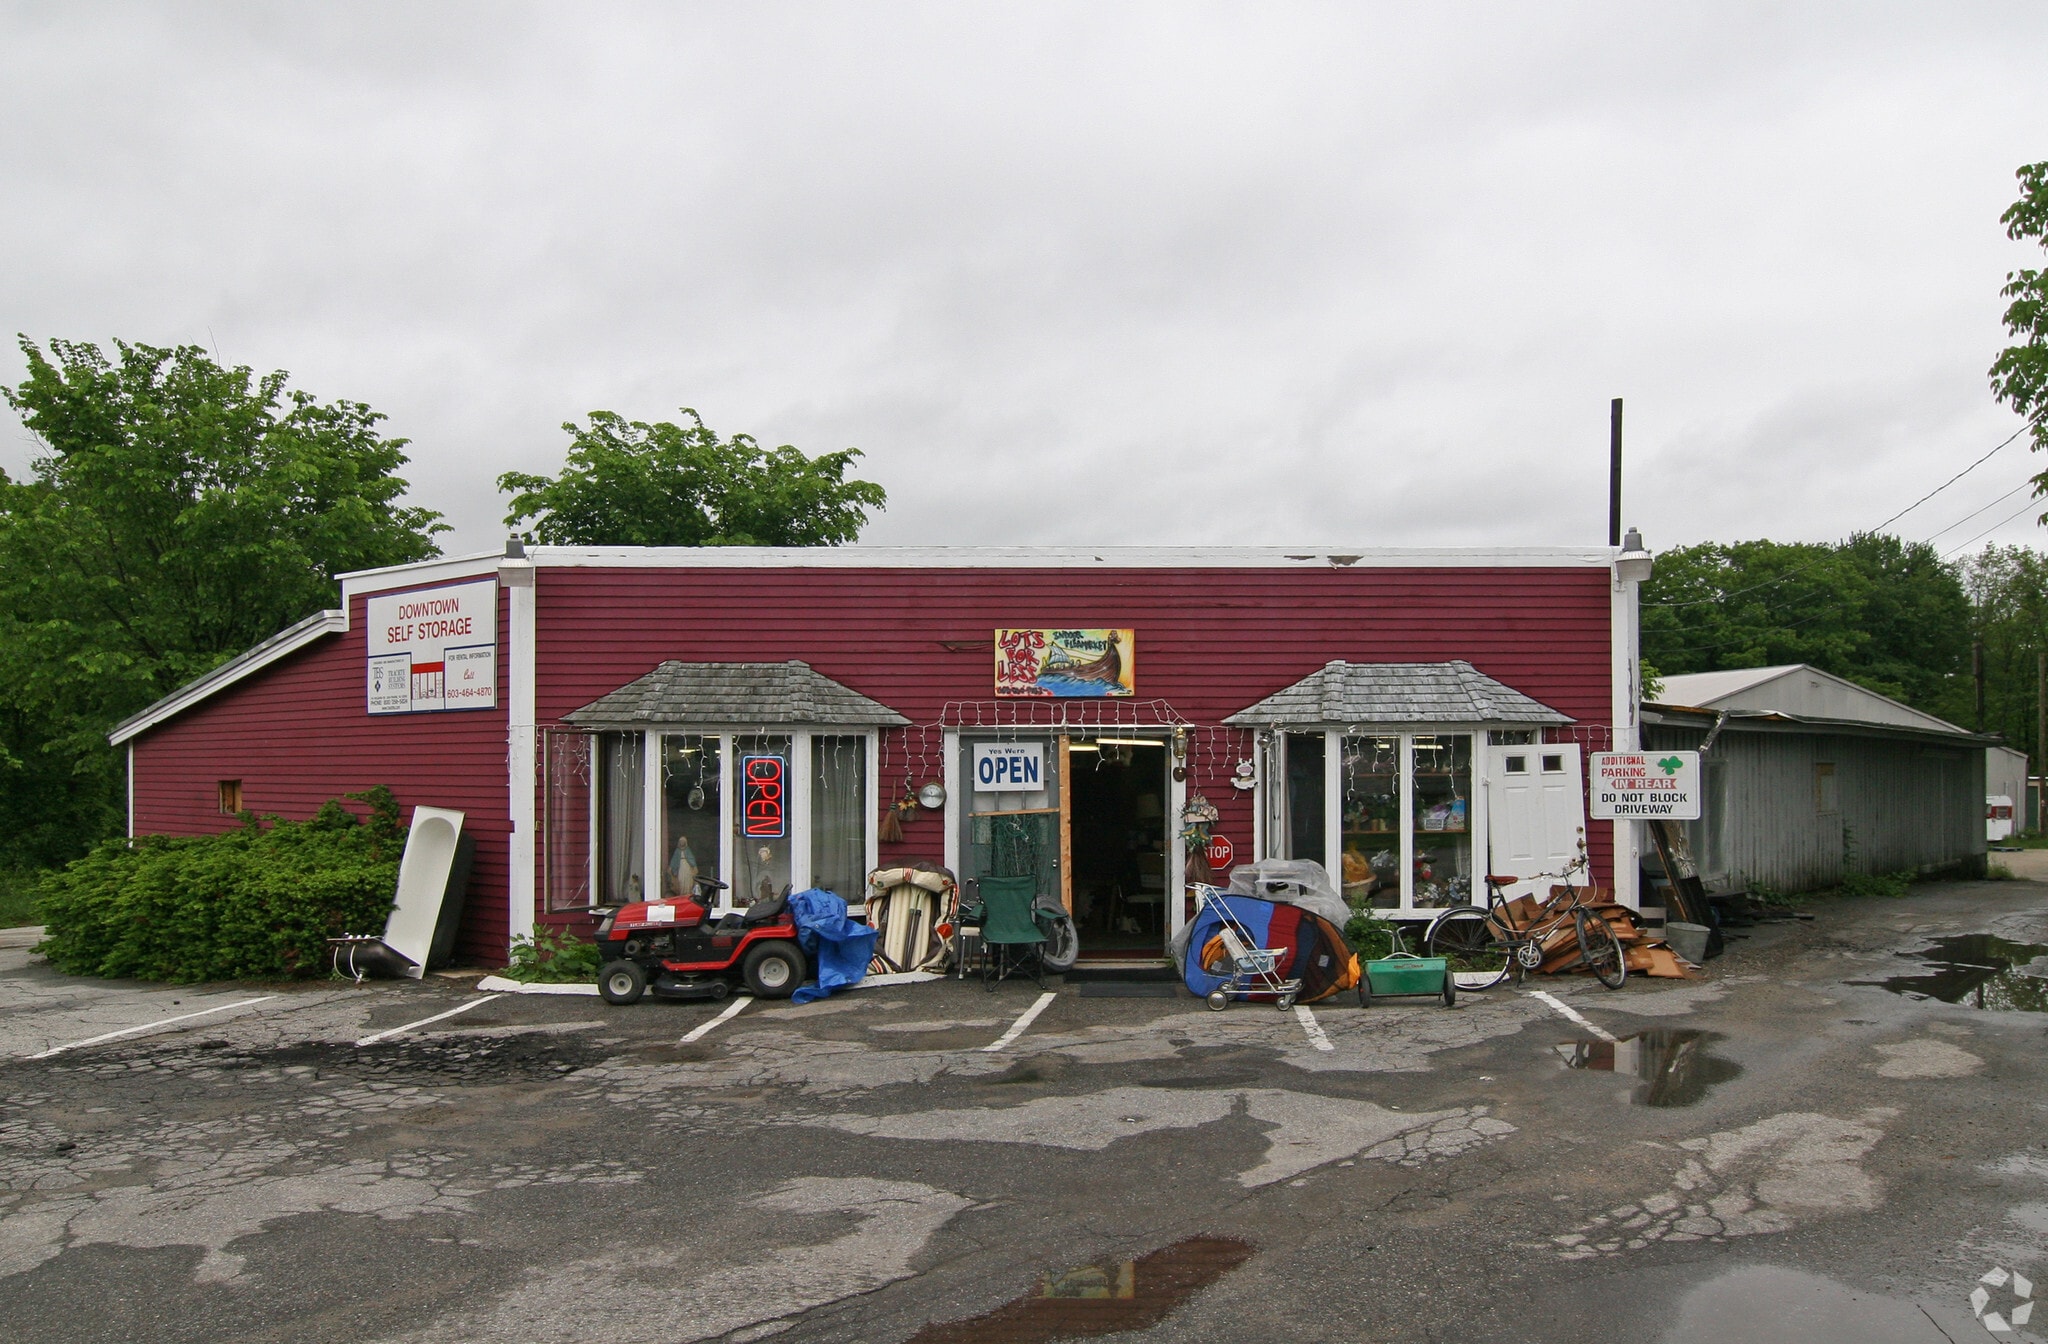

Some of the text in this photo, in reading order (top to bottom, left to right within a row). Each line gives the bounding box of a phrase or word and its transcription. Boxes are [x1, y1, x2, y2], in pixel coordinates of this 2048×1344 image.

[399, 598, 459, 620] DOWNTOWN
[387, 617, 472, 644] SELF STORAGE
[998, 630, 1045, 649] LOTS
[1005, 647, 1040, 666] FOR
[997, 660, 1037, 684] LESS
[447, 687, 492, 698] 603-464-4870
[979, 756, 1038, 784] OPEN
[1601, 756, 1645, 766] ADDITIONAL
[1601, 768, 1646, 777] PARKING
[1615, 779, 1672, 788] IN REAR
[747, 759, 781, 834] OPEN
[1602, 794, 1687, 802] DO NOT BLOCK
[1614, 805, 1673, 814] DRIVEWAY
